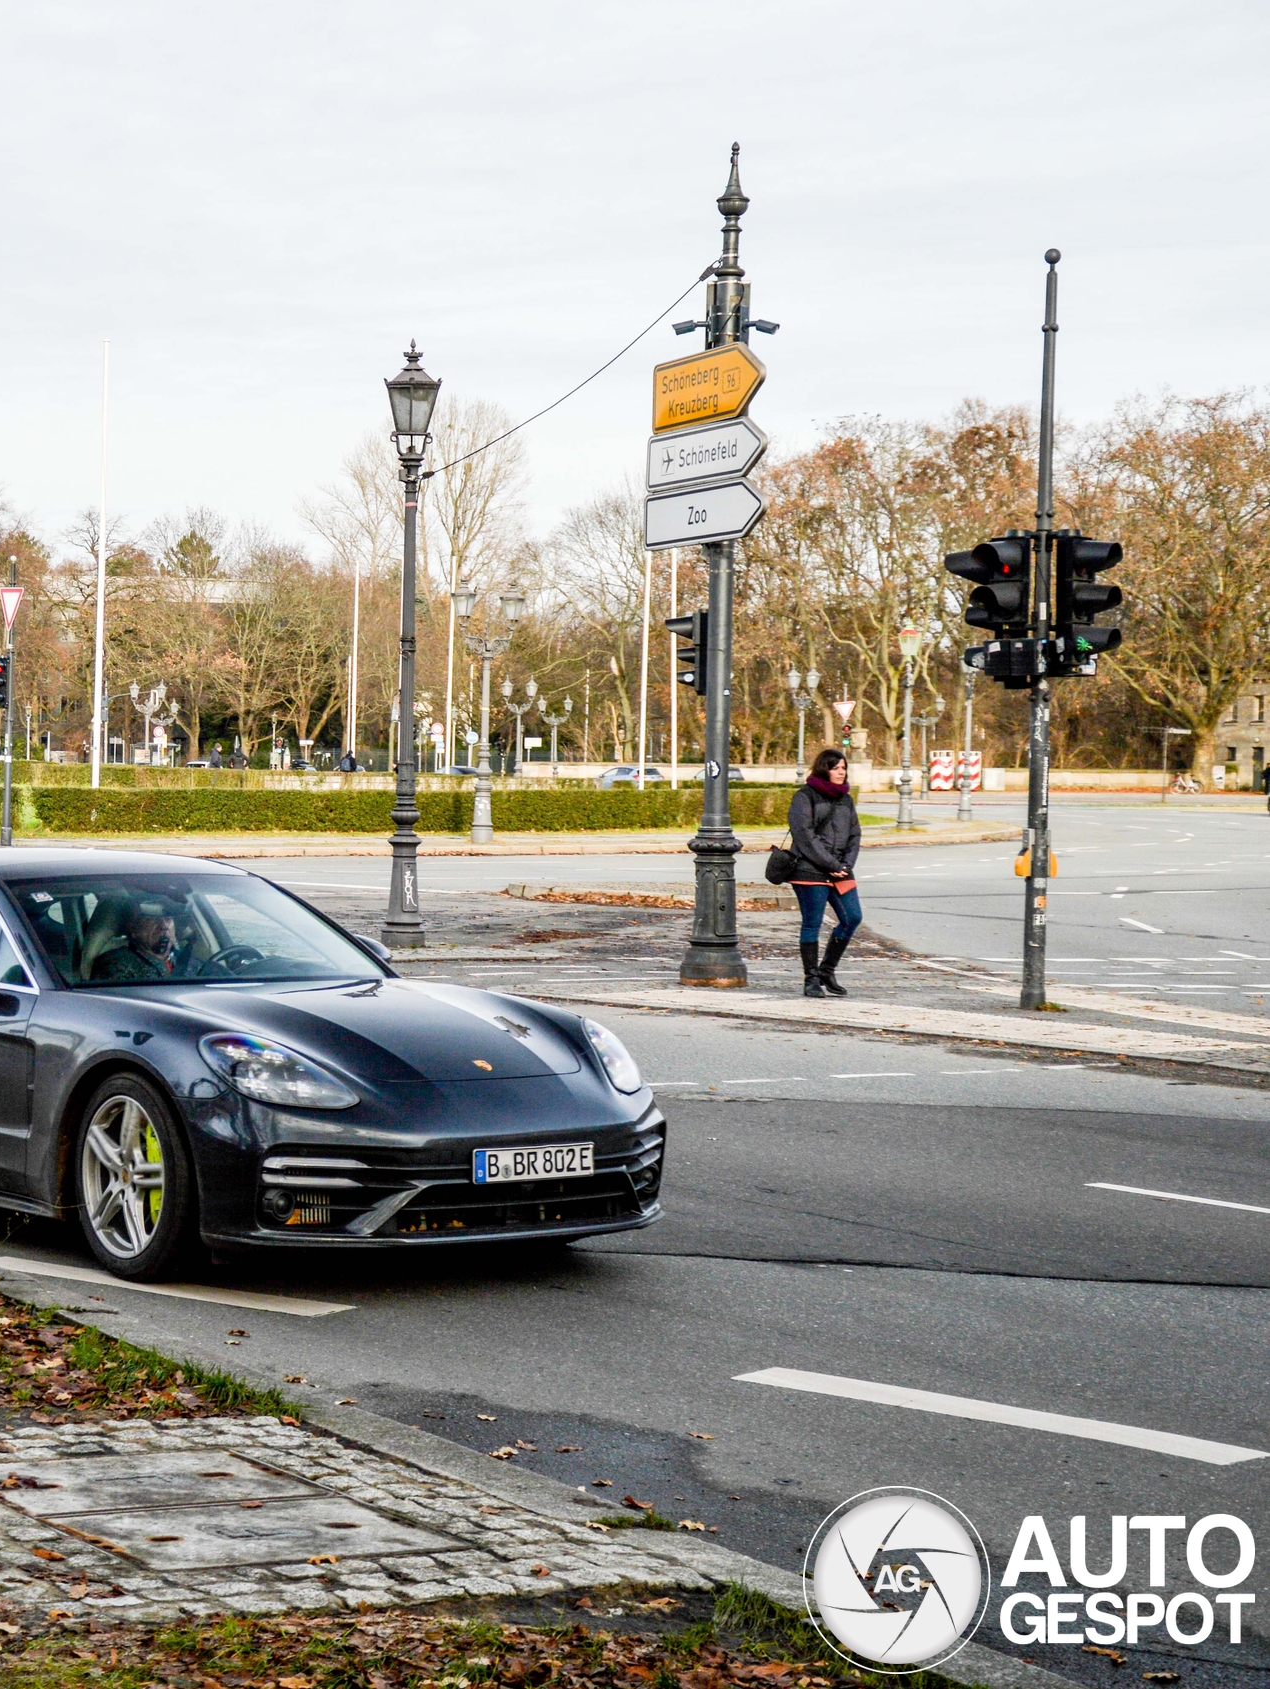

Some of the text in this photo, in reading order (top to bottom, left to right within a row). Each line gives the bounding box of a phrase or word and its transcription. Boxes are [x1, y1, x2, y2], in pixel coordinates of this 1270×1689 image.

[662, 366, 736, 395] Schöneberg 96
[668, 393, 719, 419] Kreuzberg
[679, 438, 738, 468] Schönefeld
[687, 506, 708, 525] Zoo
[487, 1154, 500, 1178] B
[513, 1151, 539, 1176] BR
